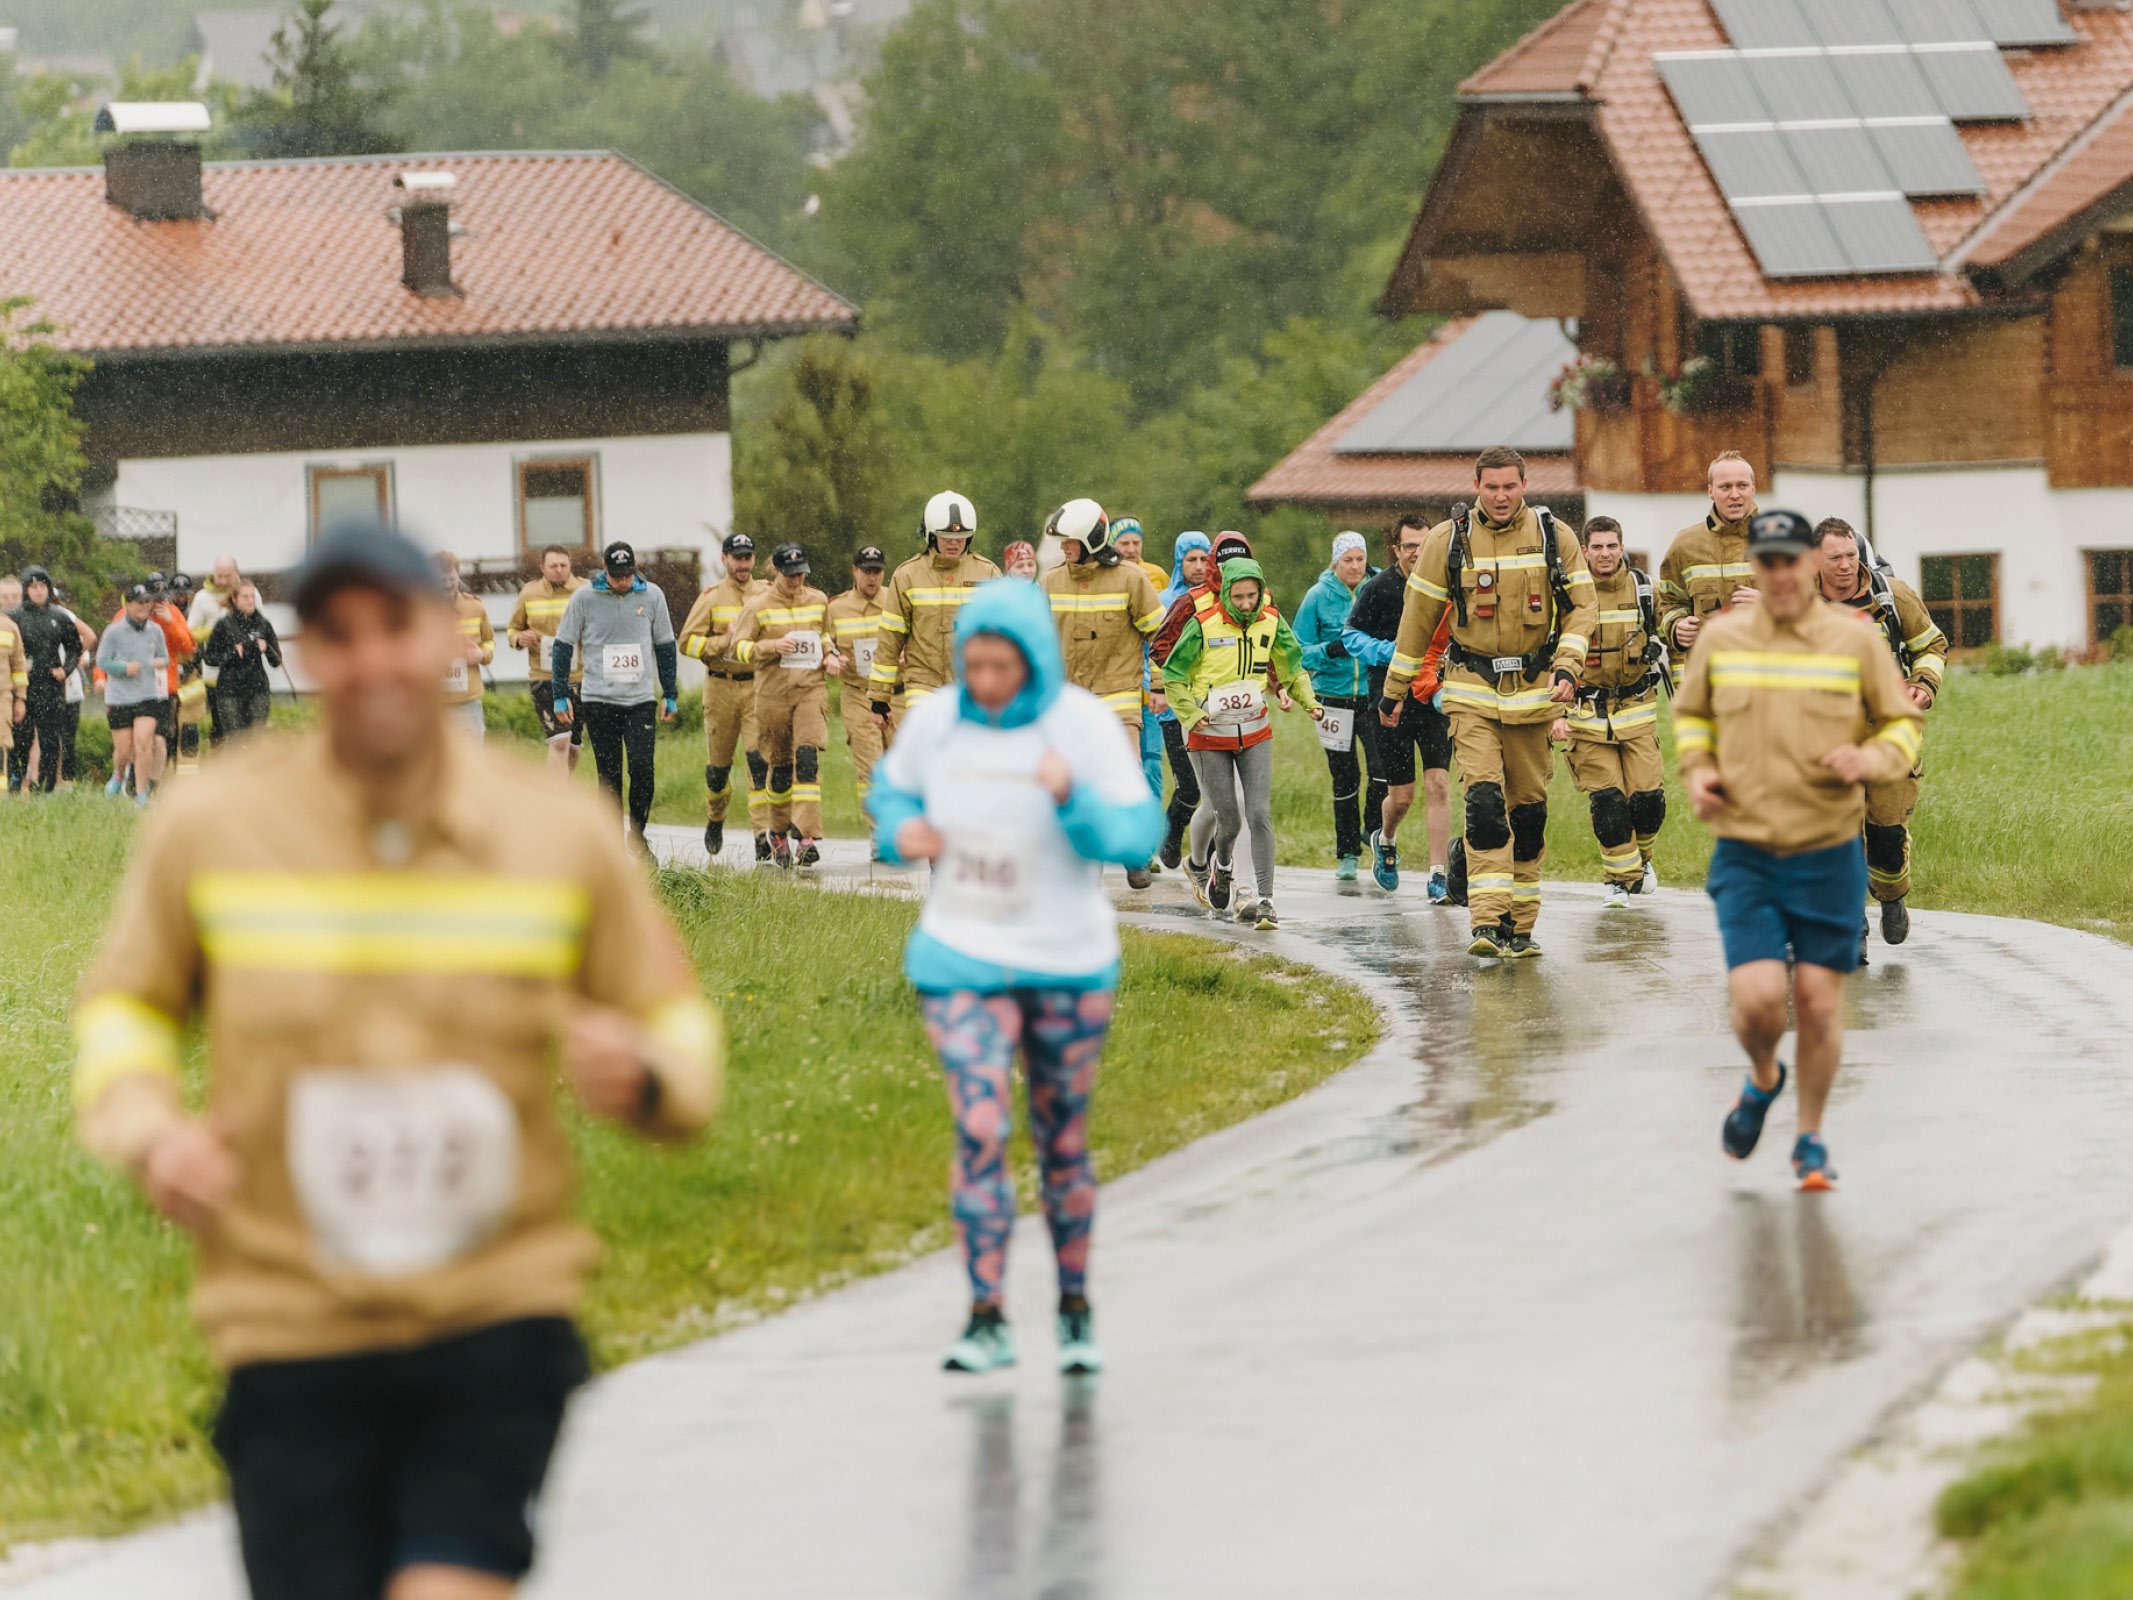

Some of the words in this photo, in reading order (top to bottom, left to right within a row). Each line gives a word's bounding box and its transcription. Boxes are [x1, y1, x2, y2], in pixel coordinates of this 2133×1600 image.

[1221, 546, 1246, 555] TERREX
[792, 641, 816, 654] 351
[612, 655, 639, 668] 238
[1495, 659, 1519, 669] MSA
[1219, 693, 1253, 711] 382
[1321, 718, 1340, 733] 46
